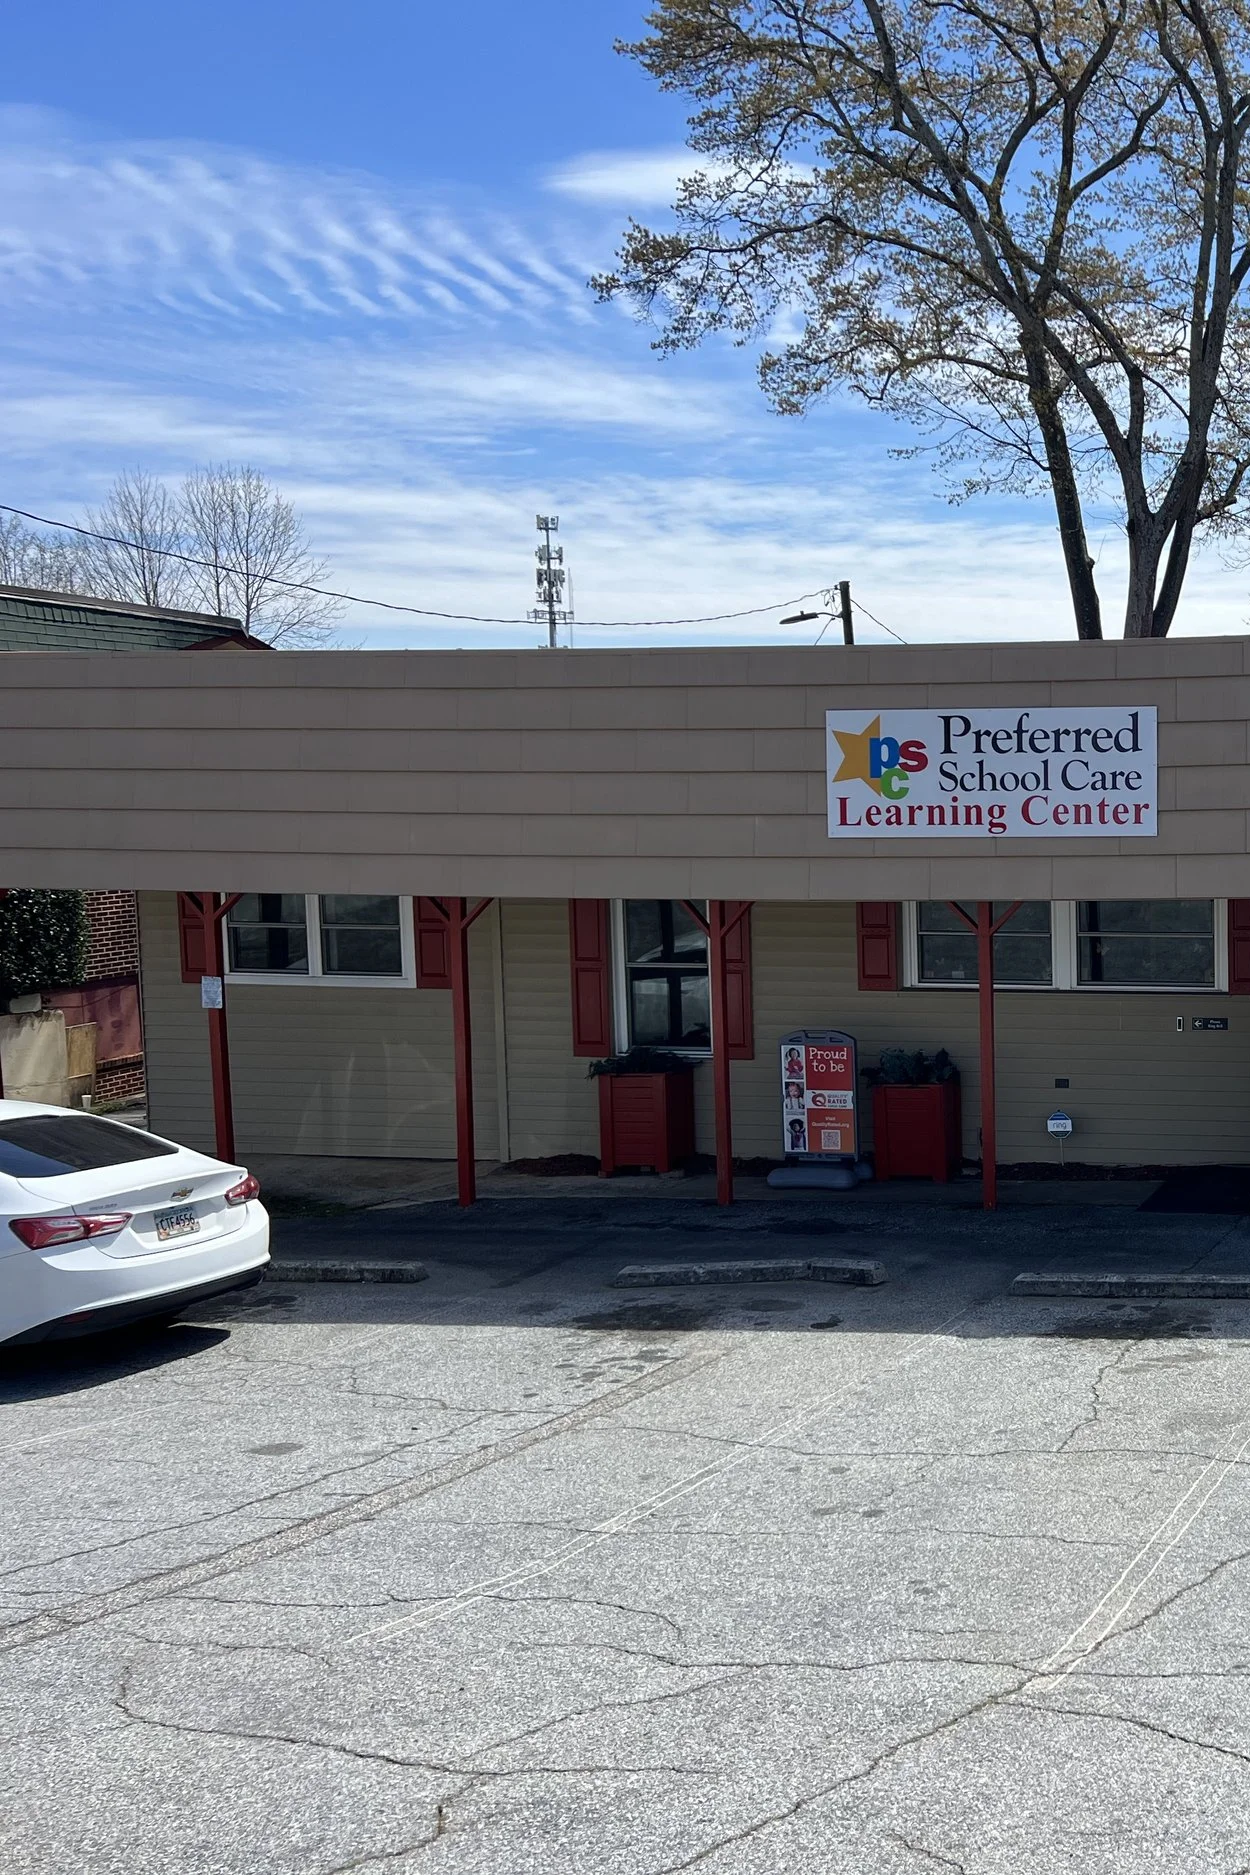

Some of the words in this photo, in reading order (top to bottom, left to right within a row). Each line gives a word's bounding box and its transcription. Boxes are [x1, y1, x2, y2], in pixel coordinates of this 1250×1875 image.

[938, 711, 1142, 755] Preferred
[938, 759, 1052, 792] School
[1060, 759, 1143, 792] Care
[835, 796, 1008, 835] Learning
[1020, 795, 1150, 826] Center
[809, 1047, 847, 1060] Proud
[812, 1060, 826, 1072] to
[830, 1061, 845, 1072] be
